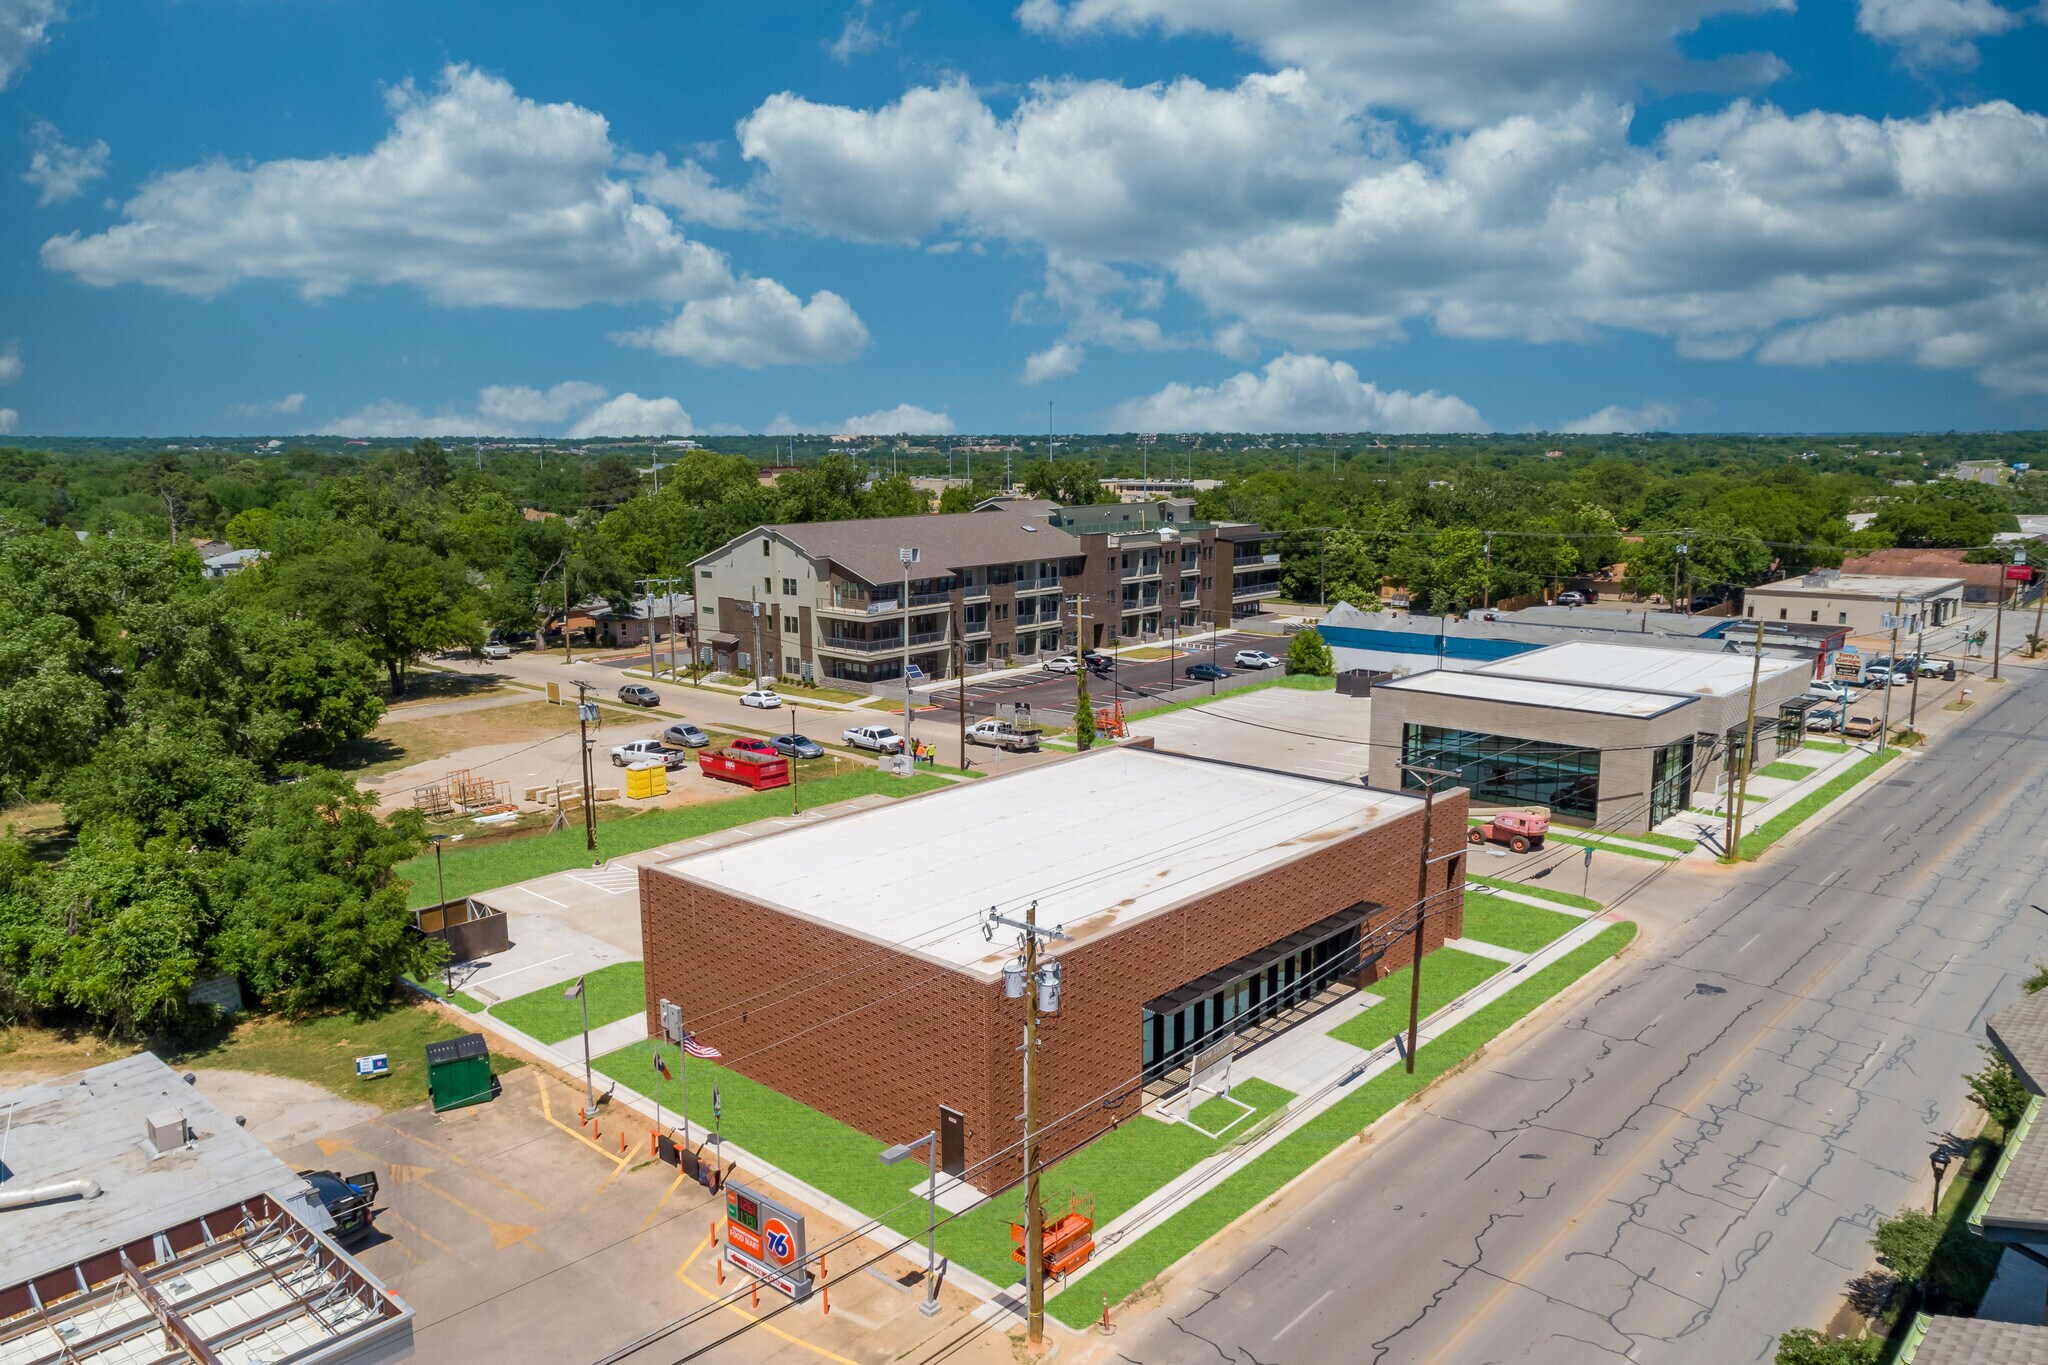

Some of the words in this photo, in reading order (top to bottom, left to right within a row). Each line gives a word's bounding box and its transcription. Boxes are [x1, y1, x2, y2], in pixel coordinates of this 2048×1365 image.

[1836, 657, 1861, 665] Garage
[730, 1229, 744, 1242] FOOD
[744, 1236, 759, 1251] MART
[766, 1229, 789, 1258] 76
